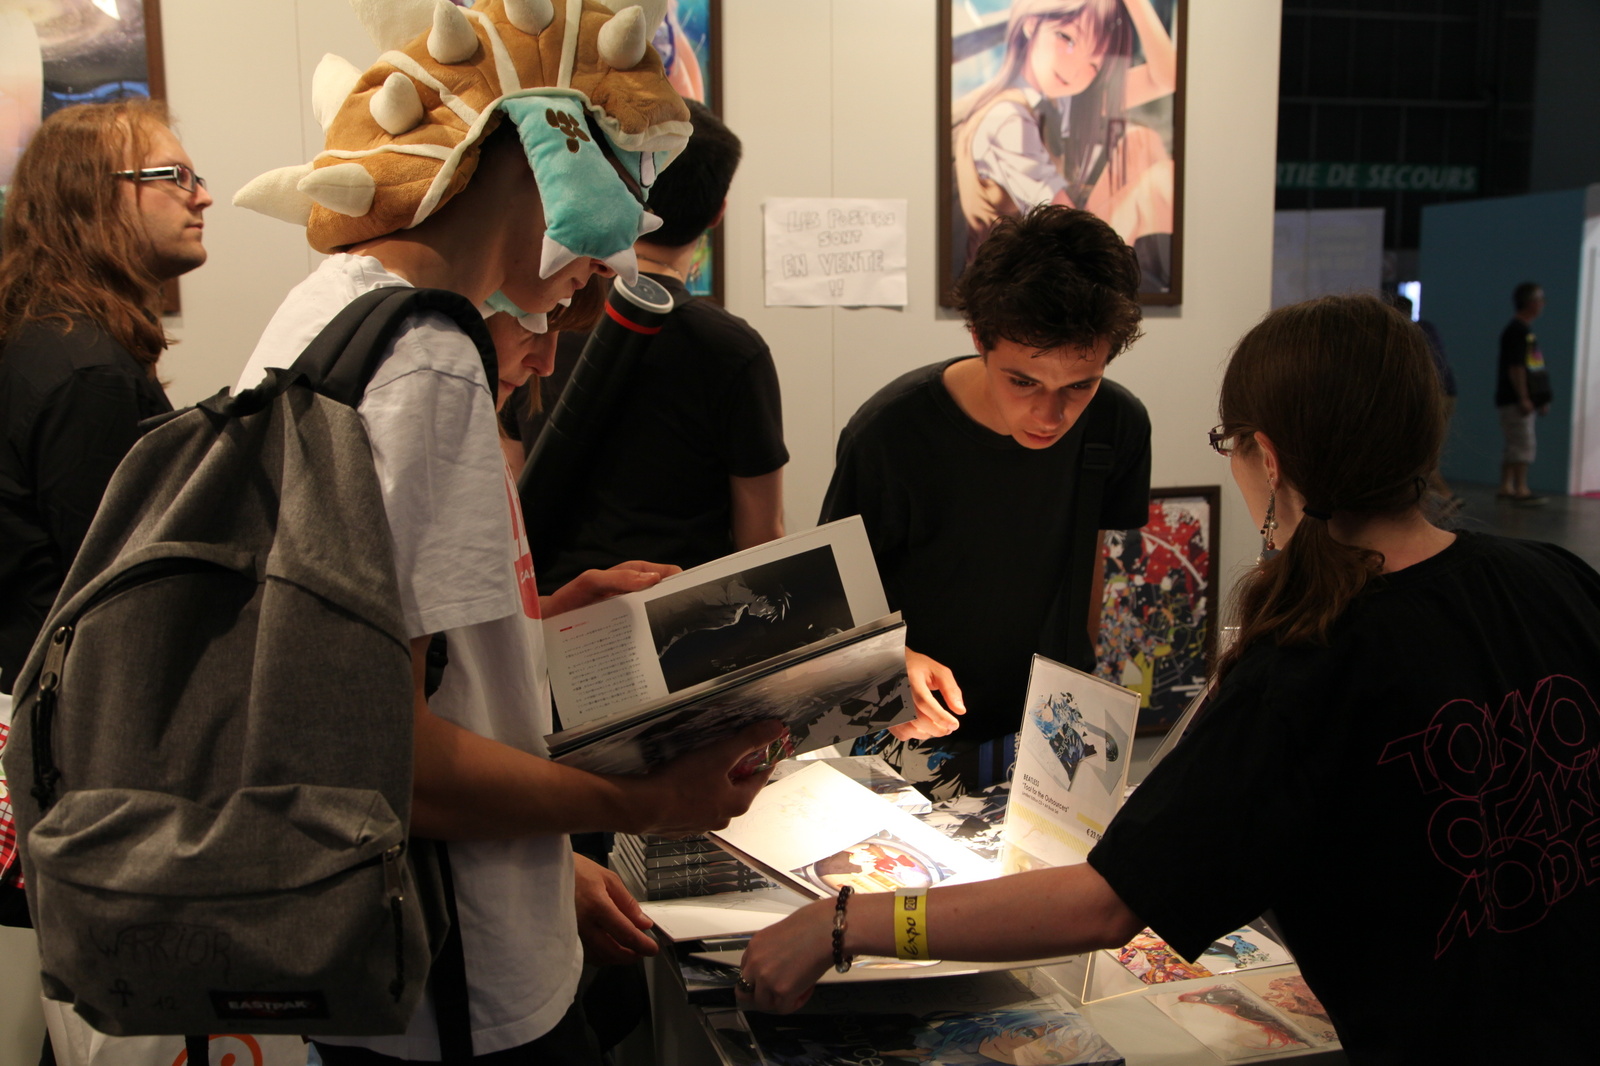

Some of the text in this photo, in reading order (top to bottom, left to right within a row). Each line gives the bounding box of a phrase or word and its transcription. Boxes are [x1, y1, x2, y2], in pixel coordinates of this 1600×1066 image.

[1325, 163, 1359, 187] DE
[1367, 165, 1478, 190] SECOURS
[817, 230, 862, 247] SONT
[781, 249, 884, 279] EN VENTE
[1377, 674, 1600, 798] TOKYO
[1023, 773, 1040, 787] BEATLESS
[903, 916, 921, 956] Expo
[226, 999, 308, 1012] EASTPAK
